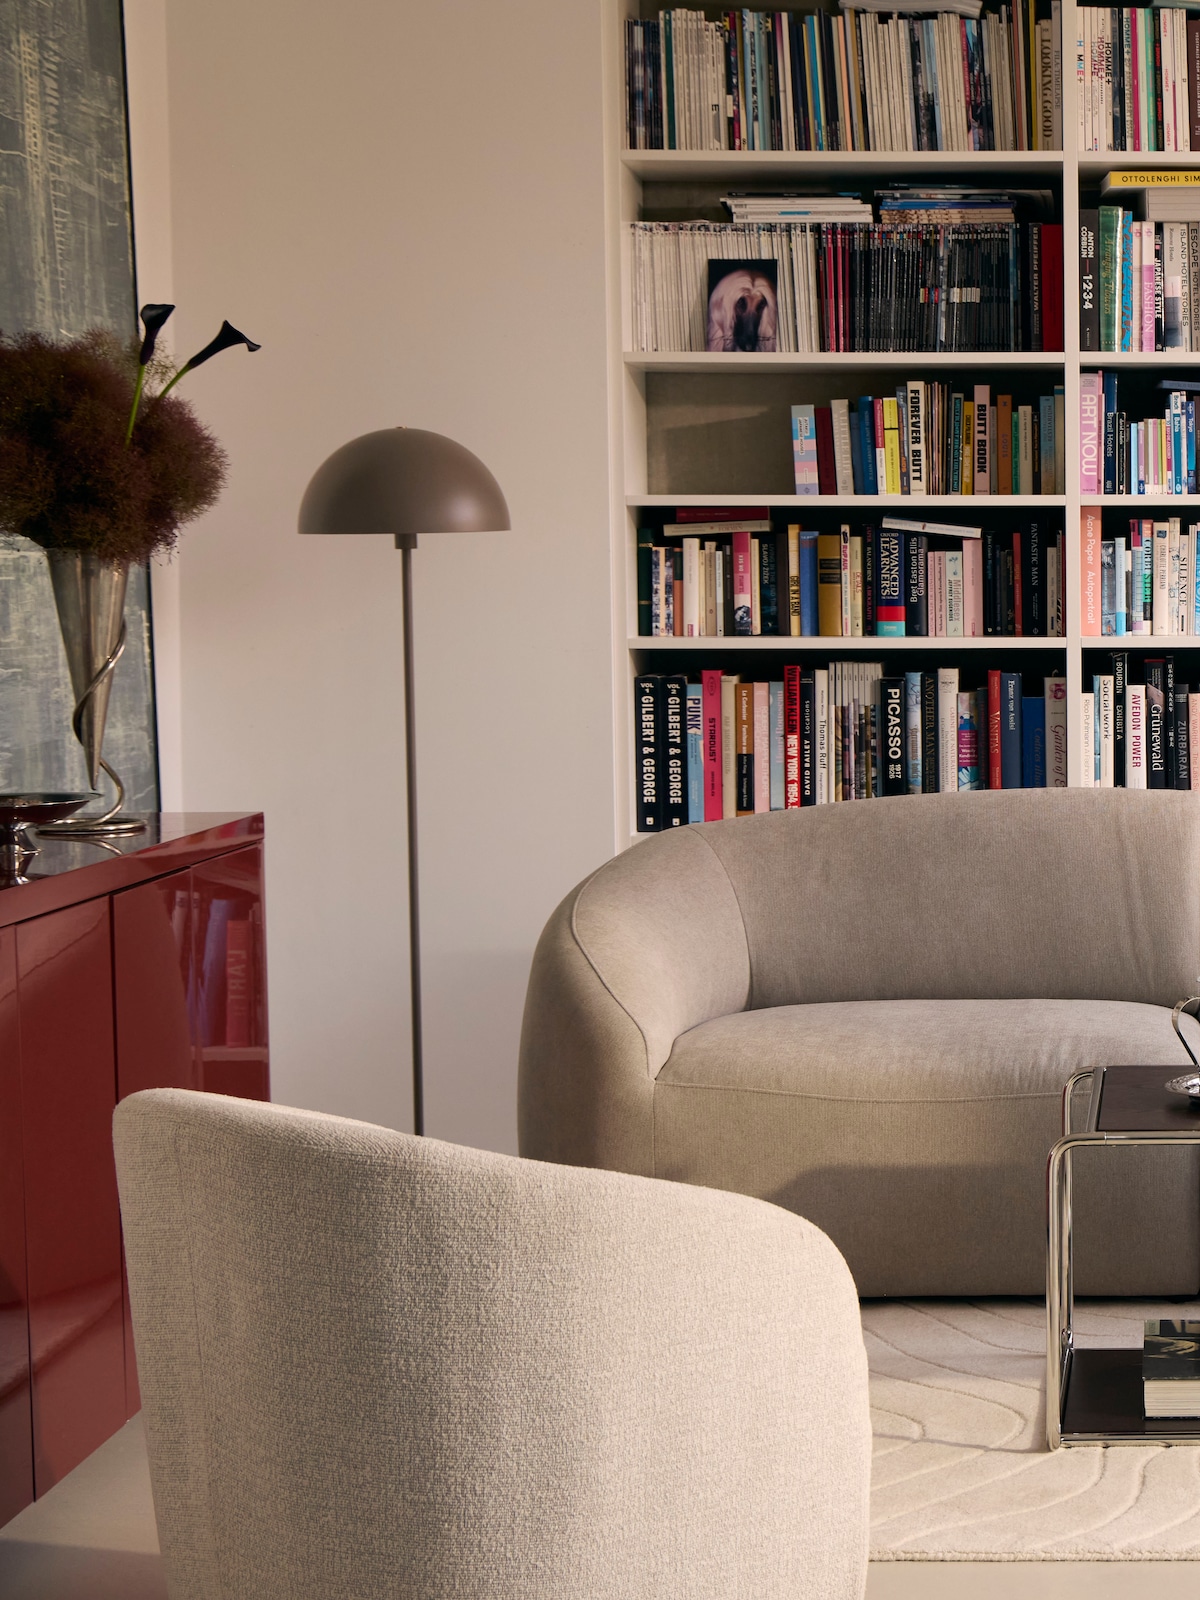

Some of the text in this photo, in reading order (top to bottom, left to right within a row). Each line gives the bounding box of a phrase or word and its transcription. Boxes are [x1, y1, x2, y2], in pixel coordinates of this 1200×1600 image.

[1042, 39, 1053, 137] LOOKING GOOD
[1082, 274, 1093, 309] 1-2-3-4
[1144, 281, 1153, 332] FASHION
[911, 390, 922, 482] FOREVER BUTT
[977, 404, 986, 473] BUTT BOOK
[1082, 394, 1097, 475] ART NOW
[881, 538, 889, 596] LEARNER'S
[890, 538, 899, 595] ADVANCED
[1085, 515, 1095, 624] Acne Paper Autoportrait
[641, 695, 655, 803] GILBERT & GEORGE
[687, 698, 701, 731] PUNK
[887, 688, 901, 759] PICASSO
[990, 711, 1000, 754] VANITAS
[1132, 694, 1141, 768] AVEDON POWER
[1151, 704, 1163, 771] Grünewald
[668, 696, 682, 804] GILBERT & GEORGE
